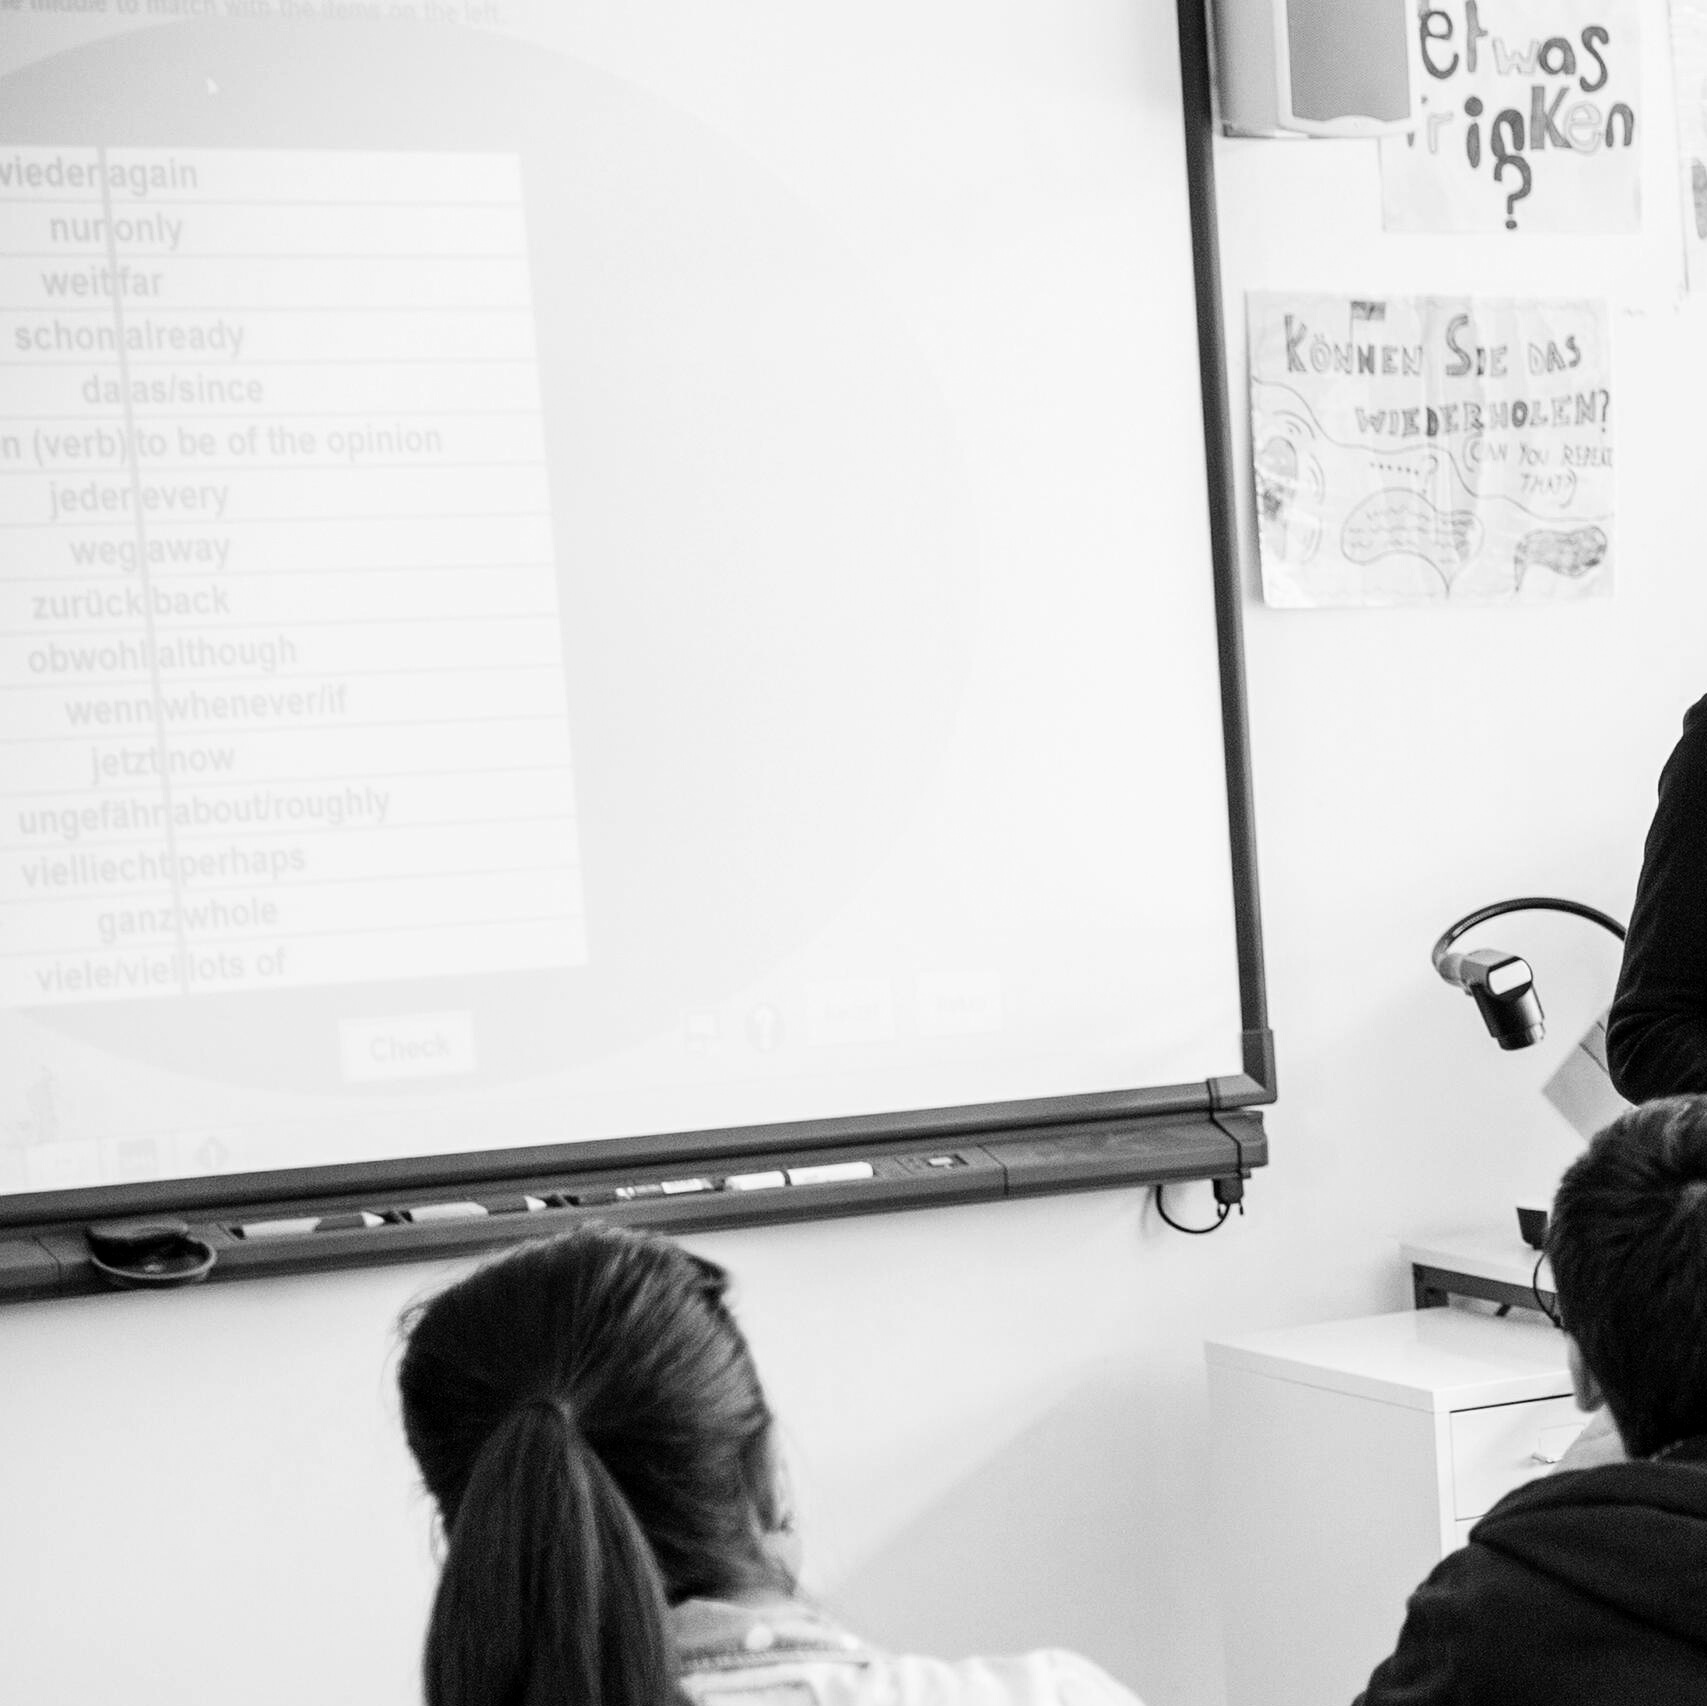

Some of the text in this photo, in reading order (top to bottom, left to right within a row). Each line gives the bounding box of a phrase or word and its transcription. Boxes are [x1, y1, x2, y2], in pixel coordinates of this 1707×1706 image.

[109, 157, 199, 196] again
[50, 212, 184, 251] nur only
[41, 264, 164, 297] weit far
[14, 319, 245, 359] schon already
[82, 372, 264, 404] da as/since
[33, 426, 129, 467] (verb)
[136, 430, 168, 457] to
[179, 426, 217, 456] be
[228, 426, 259, 455] of
[268, 424, 317, 454] the
[327, 422, 443, 462] opinion
[49, 480, 230, 523] jeder every
[70, 535, 231, 572] weg away
[32, 585, 231, 620] zurück back
[28, 634, 299, 674] obwohl although
[65, 682, 350, 726] wenn whenever/if
[90, 745, 236, 786] jetzt now
[18, 785, 391, 841] ungefähr about/roughly
[179, 844, 307, 886] perhaps
[97, 897, 279, 945] ganz whole
[35, 946, 288, 993] viele/viel lots of
[369, 1031, 451, 1064] Check
